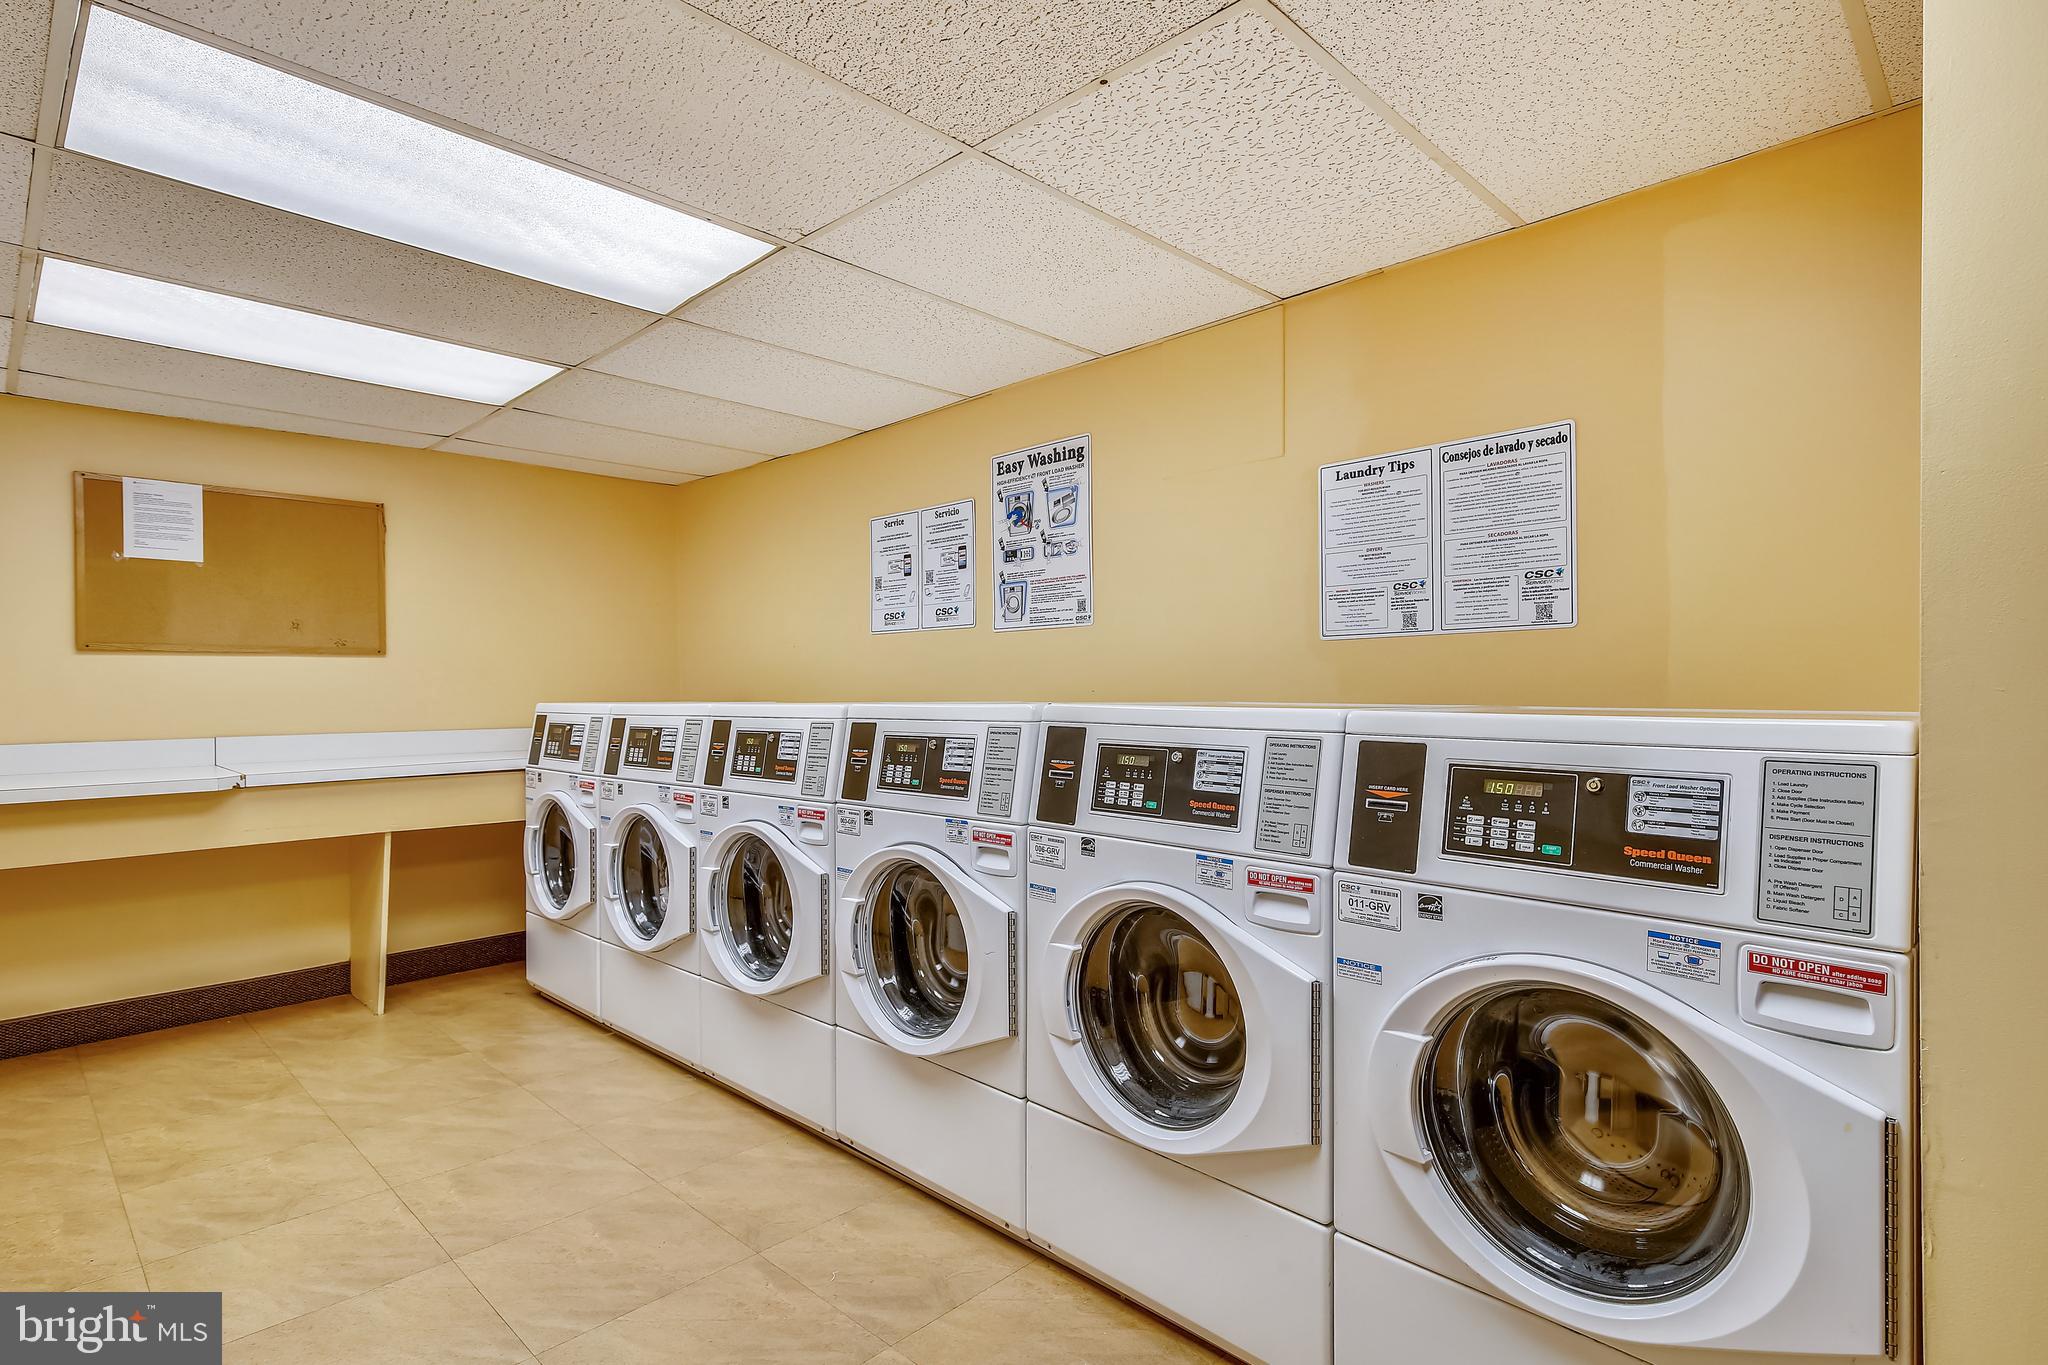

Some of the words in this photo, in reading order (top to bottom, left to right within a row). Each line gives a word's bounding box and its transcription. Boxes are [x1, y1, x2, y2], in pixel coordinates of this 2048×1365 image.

[1442, 448, 1480, 463] Consejos
[1483, 445, 1493, 456] de
[1496, 439, 1525, 454] lavado
[1528, 441, 1534, 452] y
[1536, 432, 1568, 447] secado
[997, 460, 1024, 476] Easy
[1027, 446, 1085, 469] Washing
[1487, 458, 1518, 467] LAVADORAS
[1336, 465, 1385, 481] Laundry
[1388, 461, 1415, 473] Tips
[935, 508, 959, 519] Servicio
[884, 518, 904, 528] Service
[1524, 570, 1554, 579] CSC
[1393, 582, 1418, 591] CSC
[884, 612, 900, 620] CSC
[936, 607, 953, 616] CSC
[1813, 770, 1867, 779] INSTRUCTIONS
[1190, 800, 1211, 808] Speed
[1212, 802, 1235, 811] Queen
[1769, 834, 1809, 843] DISPENSER
[1810, 836, 1864, 848] INSTRUCTIONS
[1624, 846, 1665, 859] Speed
[1667, 850, 1712, 864] Queen
[1630, 859, 1673, 871] Commercial
[1674, 864, 1703, 874] Washer
[1272, 874, 1286, 883] OPEN
[1349, 898, 1391, 912] 011-GRV
[1670, 935, 1699, 944] NOTICE
[1344, 960, 1375, 970] NOTICE
[1753, 954, 1768, 965] DO
[1772, 957, 1795, 970] NOT
[1798, 961, 1830, 975] OPEN
[1846, 974, 1866, 983] adding
[1797, 972, 1820, 981] despues
